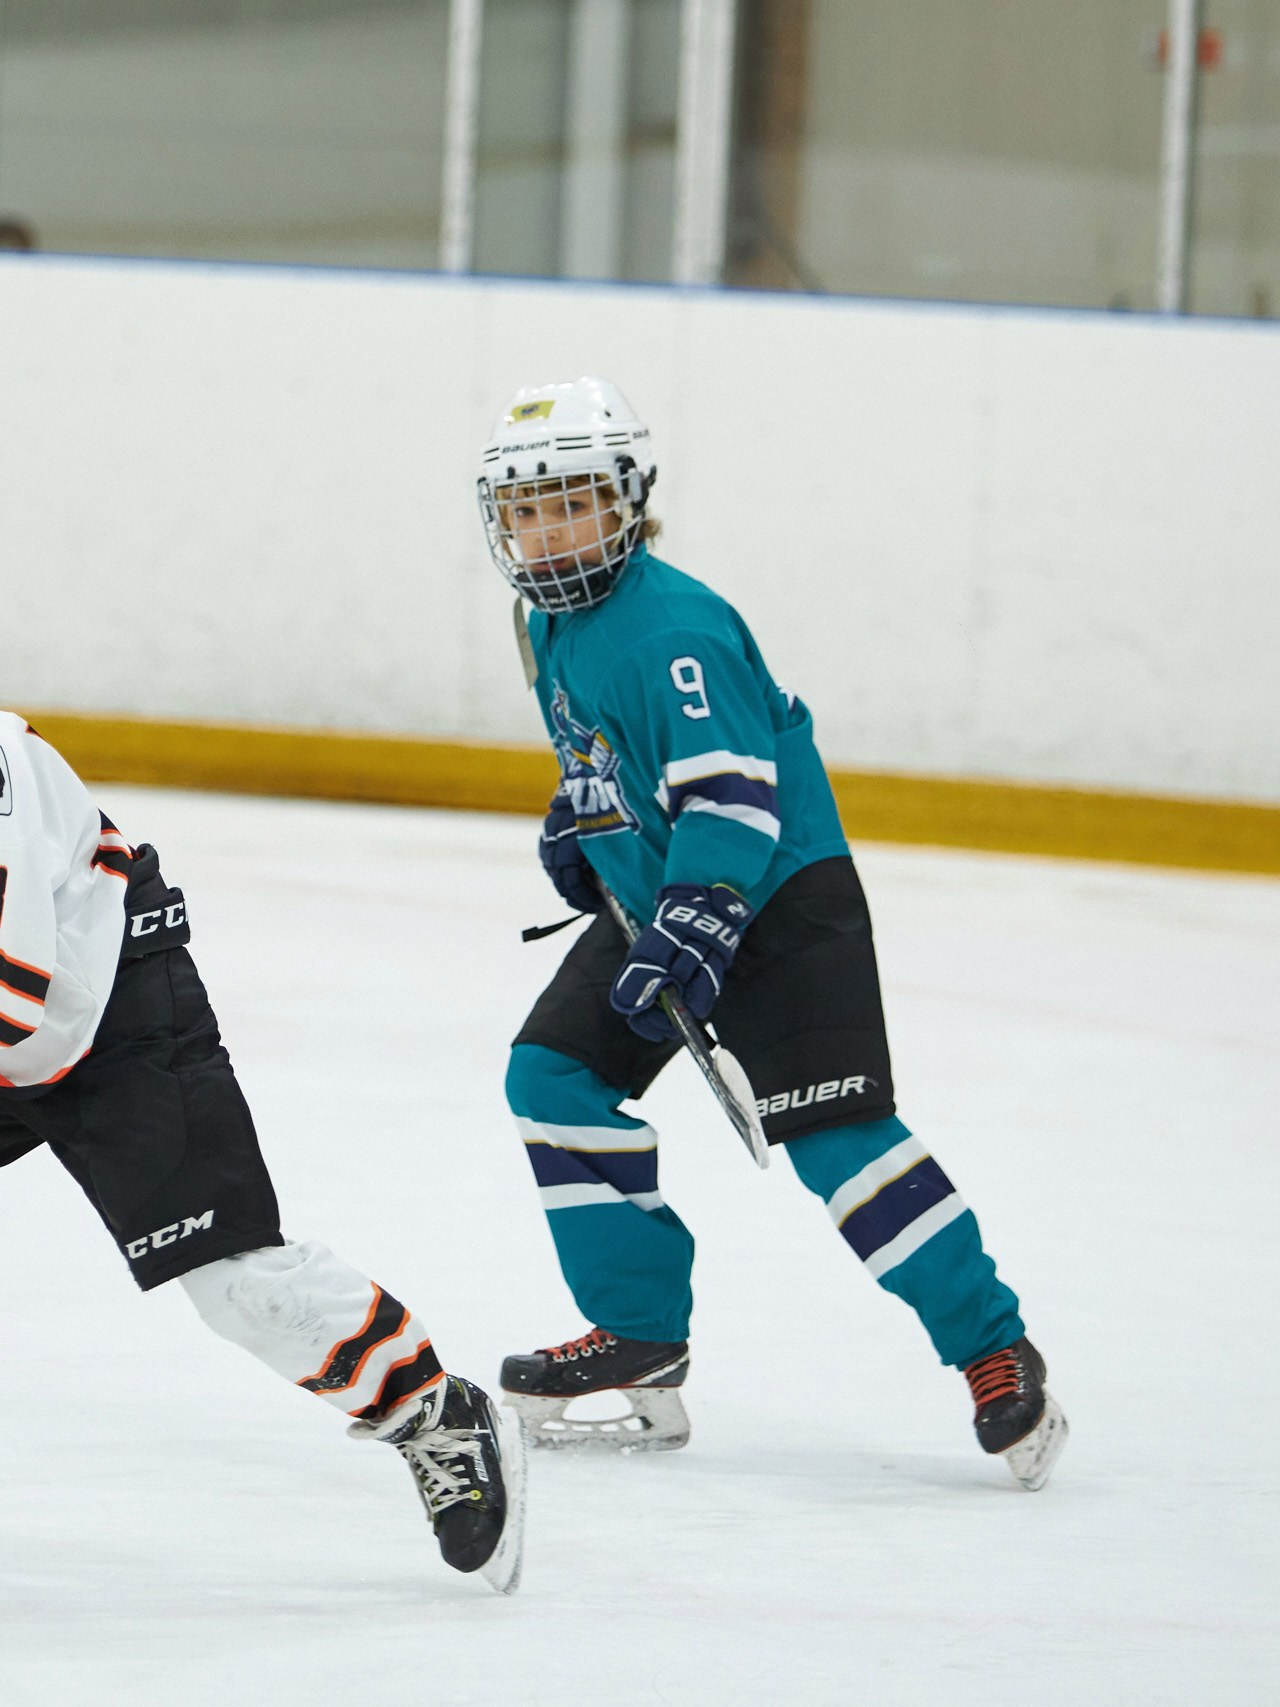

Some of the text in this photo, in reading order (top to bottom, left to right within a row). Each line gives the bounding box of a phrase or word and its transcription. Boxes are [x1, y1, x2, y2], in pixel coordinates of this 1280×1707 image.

[670, 656, 711, 720] 9
[130, 901, 189, 938] CC
[661, 905, 740, 952] BAU
[125, 1209, 215, 1260] CCM
